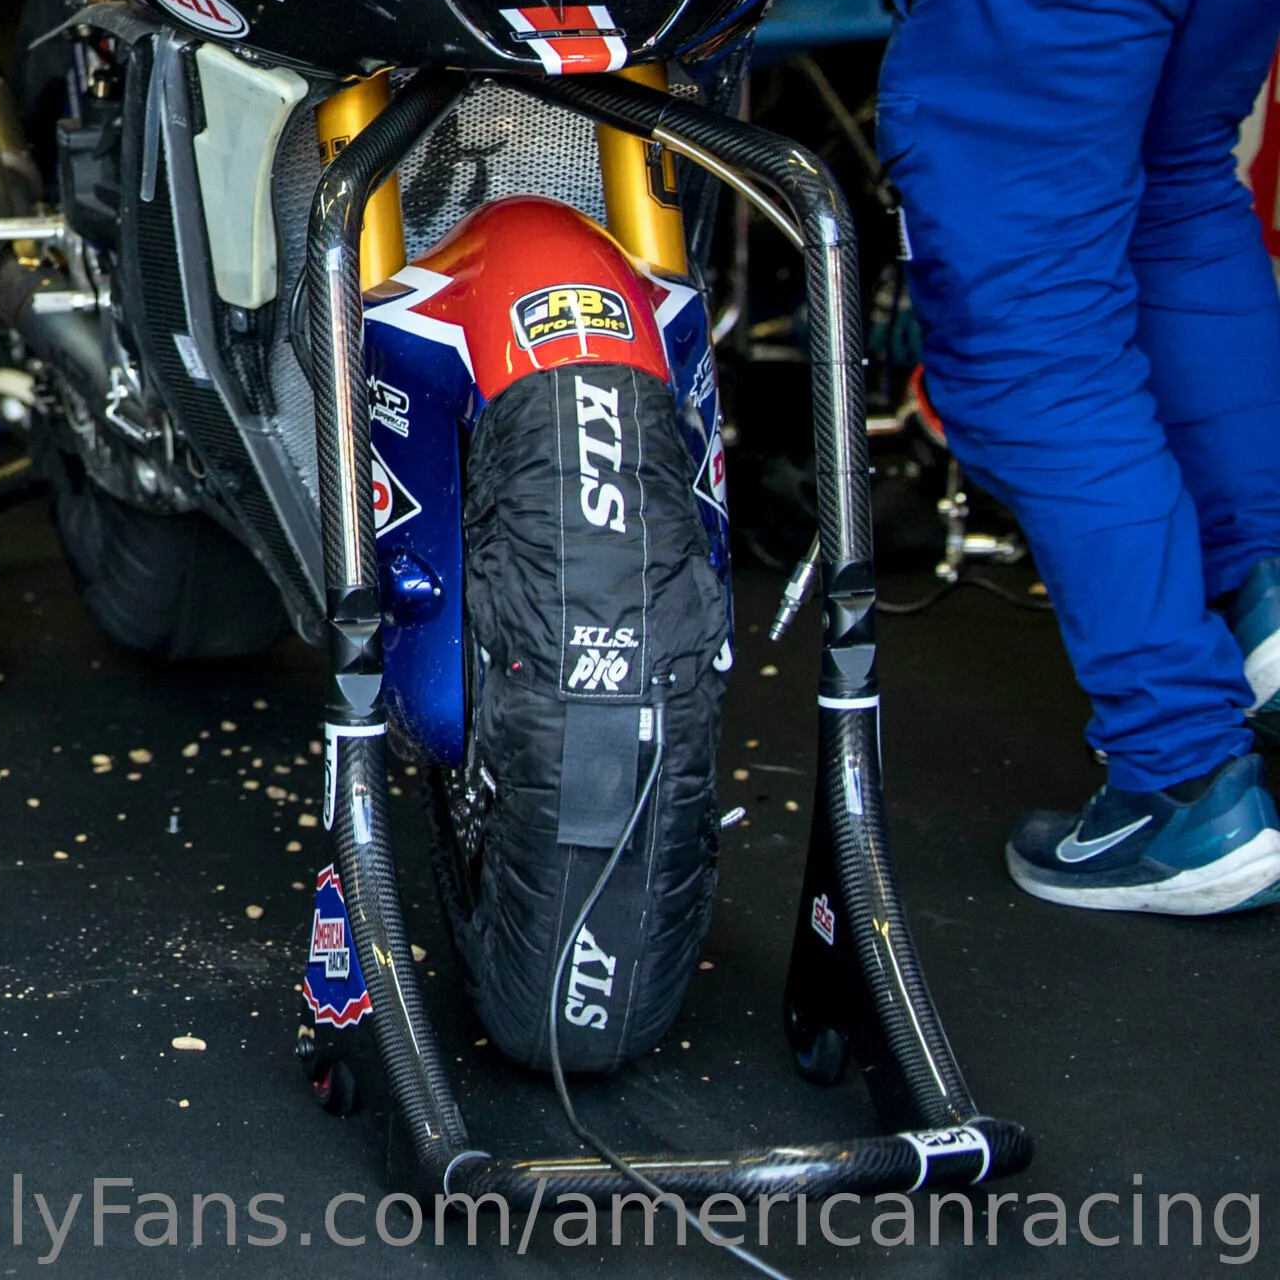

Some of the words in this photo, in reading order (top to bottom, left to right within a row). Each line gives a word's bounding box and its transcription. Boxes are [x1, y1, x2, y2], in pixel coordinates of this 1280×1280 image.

[549, 289, 603, 318] PB
[575, 375, 627, 534] KLS
[313, 910, 345, 956] AMERICAN
